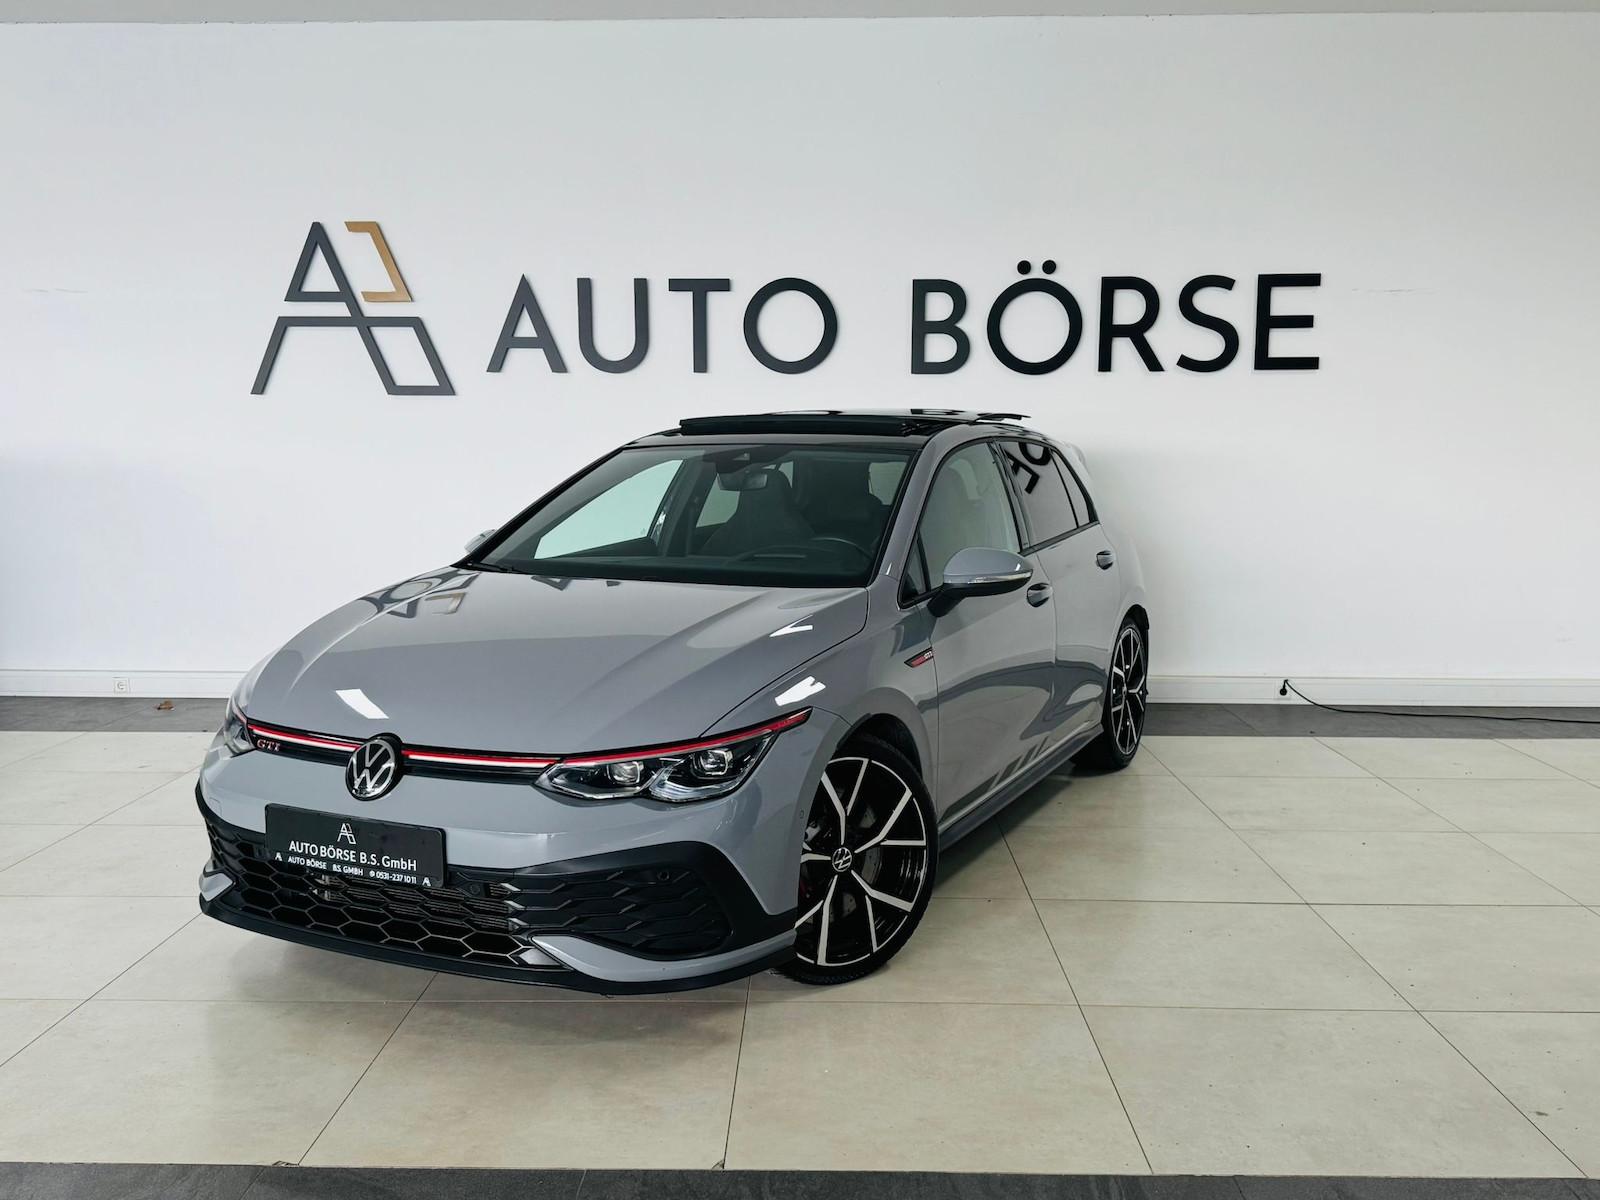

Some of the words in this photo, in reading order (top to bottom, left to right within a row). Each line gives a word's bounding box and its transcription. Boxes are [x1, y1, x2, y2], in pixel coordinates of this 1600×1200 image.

[487, 274, 838, 374] AUTO
[911, 260, 1321, 375] BÖRSE
[256, 738, 281, 752] GTI
[288, 856, 305, 865] AUTO
[306, 858, 327, 870] BÖRSE
[343, 866, 363, 876] GMBH
[289, 840, 318, 855] AUTO
[320, 845, 357, 862] BÖRSE
[360, 852, 380, 866] B.S.
[382, 855, 417, 871] GmbH
